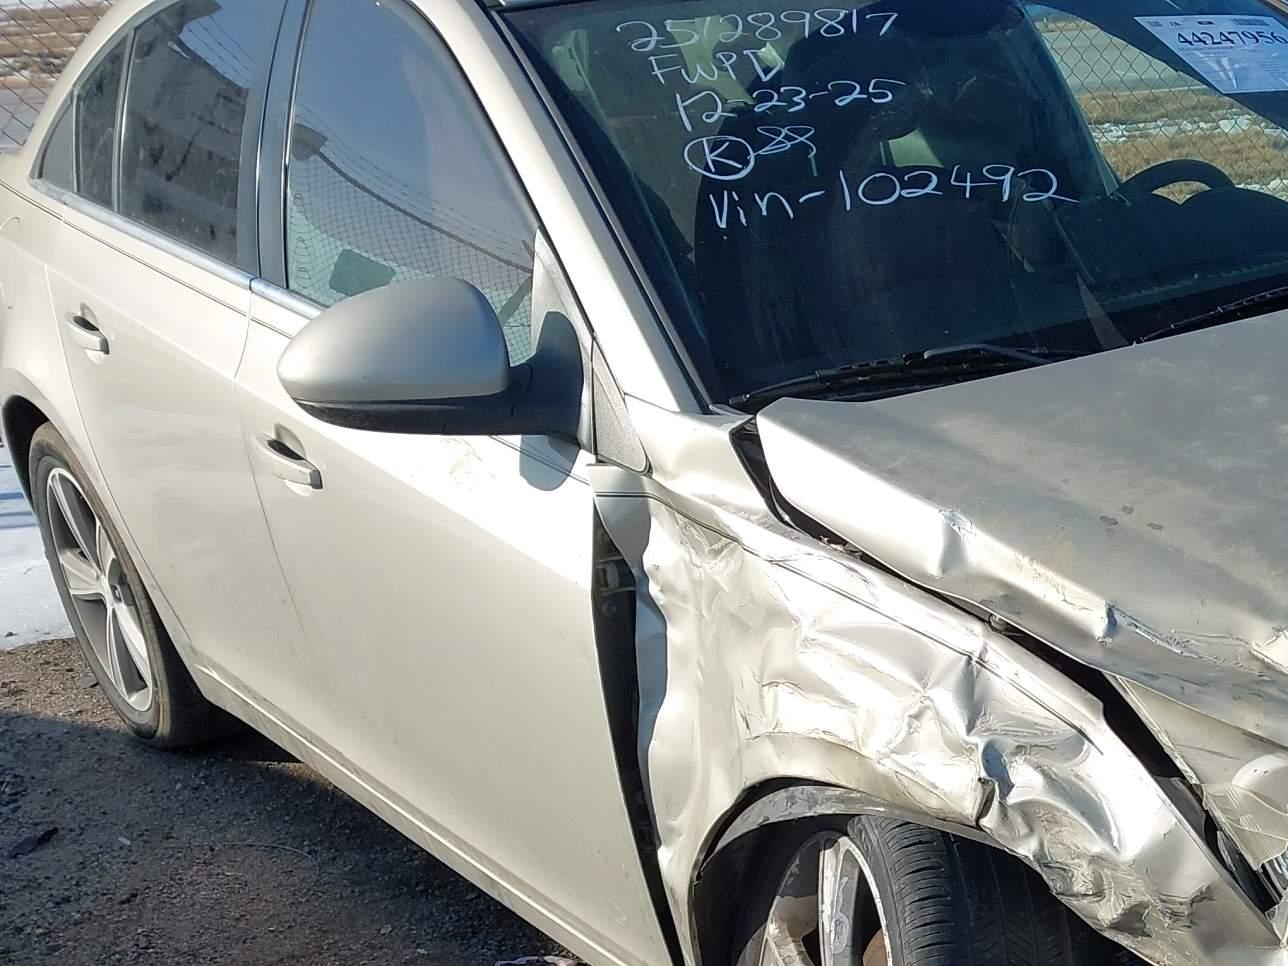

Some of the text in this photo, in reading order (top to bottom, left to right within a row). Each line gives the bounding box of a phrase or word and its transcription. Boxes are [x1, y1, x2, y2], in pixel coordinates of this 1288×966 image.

[615, 8, 900, 52] 251289817
[1177, 30, 1288, 47] 44247956
[675, 78, 906, 131] 12-23-25
